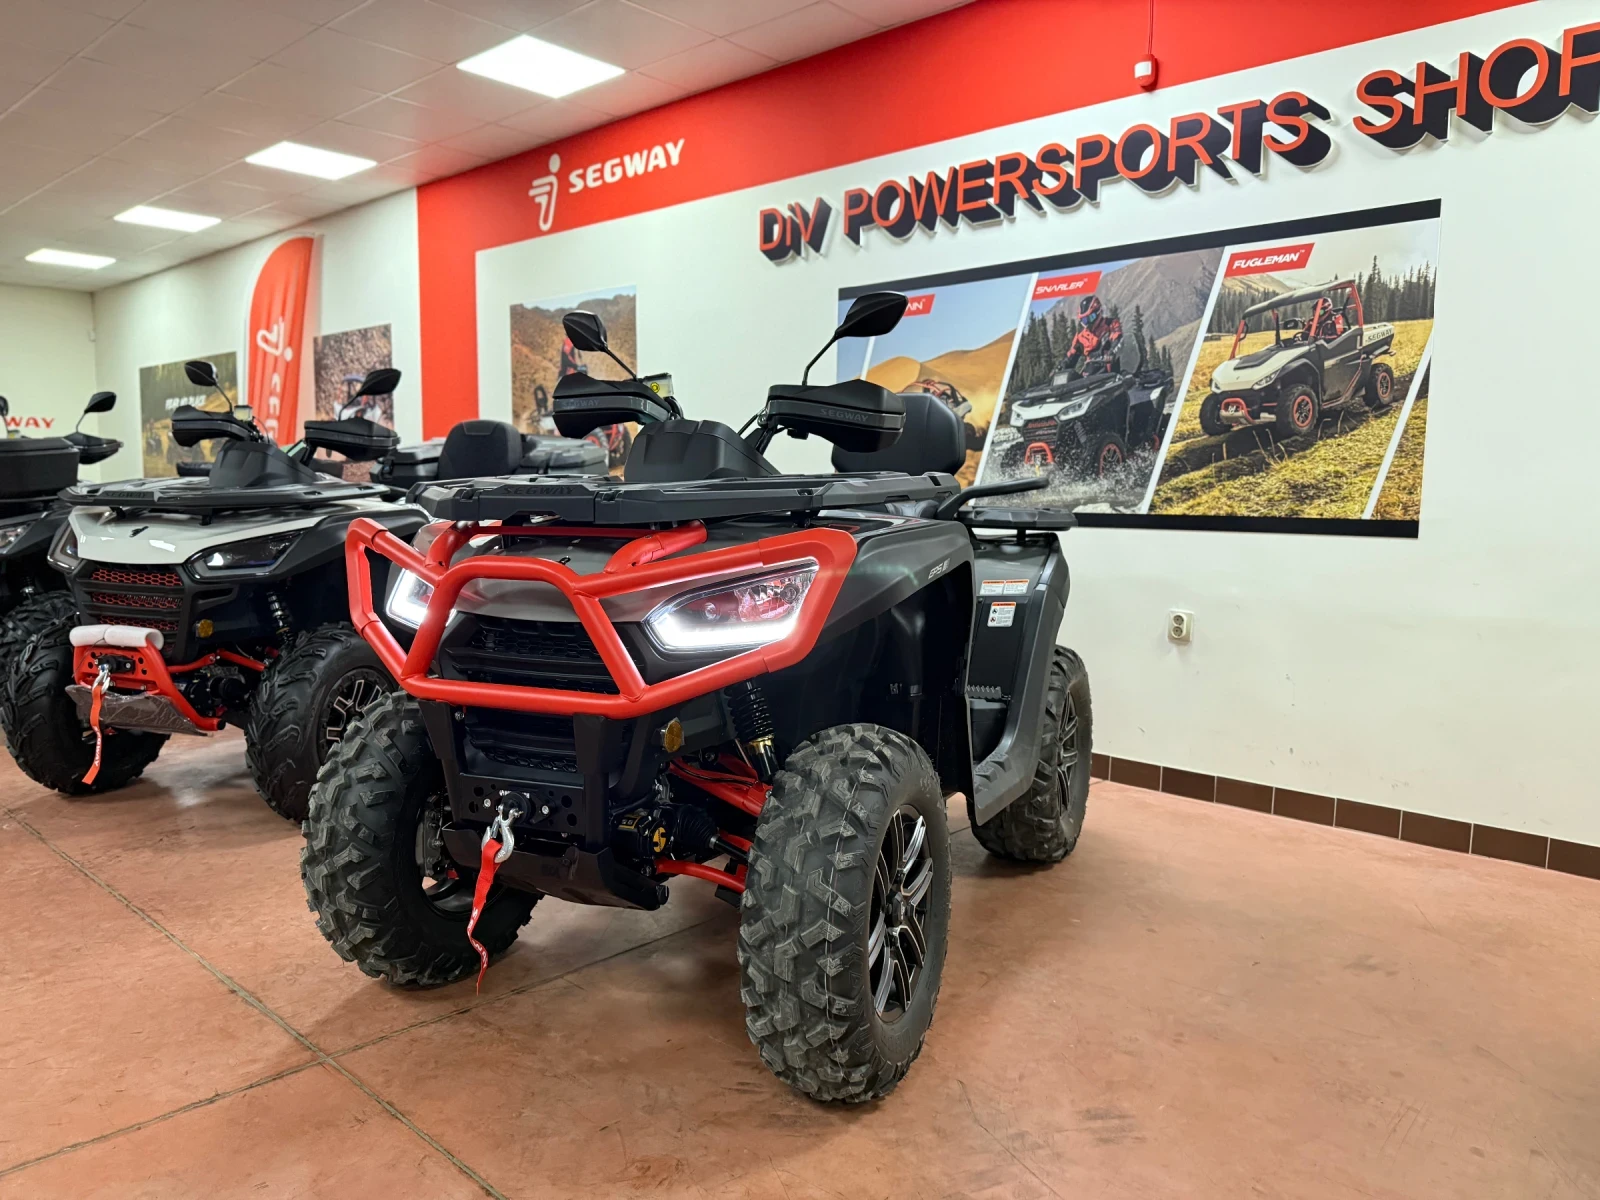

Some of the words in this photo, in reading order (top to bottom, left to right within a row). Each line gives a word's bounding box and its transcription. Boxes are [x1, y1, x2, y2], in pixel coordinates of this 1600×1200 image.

[568, 138, 685, 194] SEGWAY
[758, 197, 830, 262] DiV
[843, 91, 1330, 245] POWERSPORTS
[1232, 251, 1300, 270] FUGLEMAN
[1035, 281, 1085, 295] SNARLER
[820, 408, 869, 422] SEGWAY
[502, 486, 577, 495] SEGWAY
